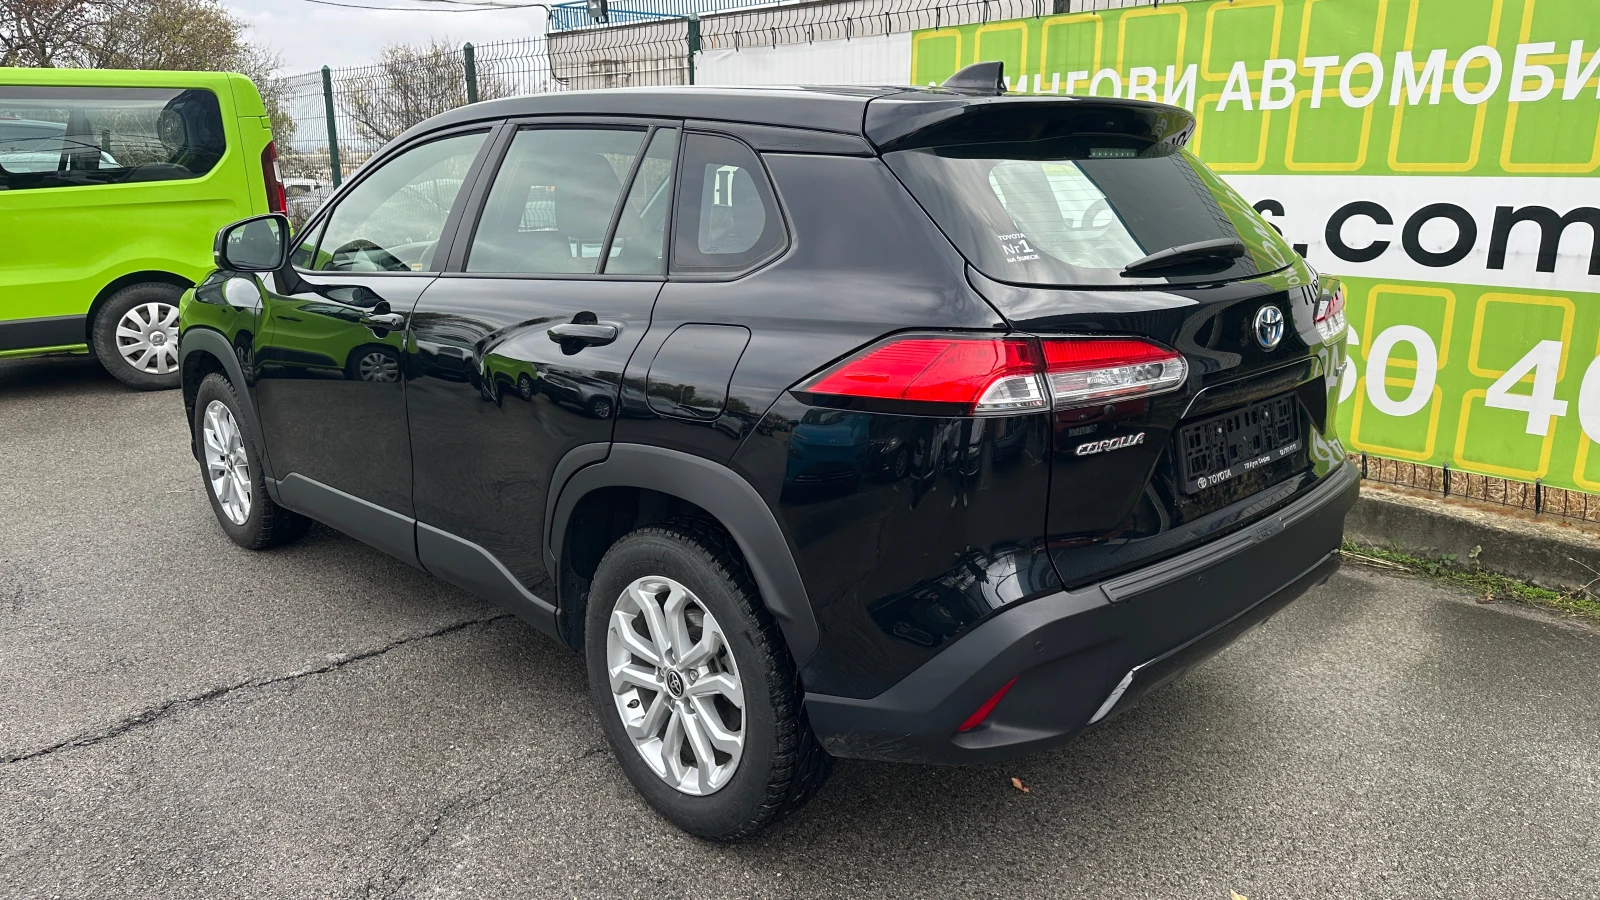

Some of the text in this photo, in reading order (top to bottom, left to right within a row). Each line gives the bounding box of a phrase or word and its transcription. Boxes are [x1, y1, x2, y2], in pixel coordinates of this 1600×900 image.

[928, 64, 1198, 113] ИНГОВИ
[997, 233, 1026, 241] TOYOTA
[1076, 432, 1146, 456] COROLLA
[1208, 469, 1232, 485] TOYOTA
